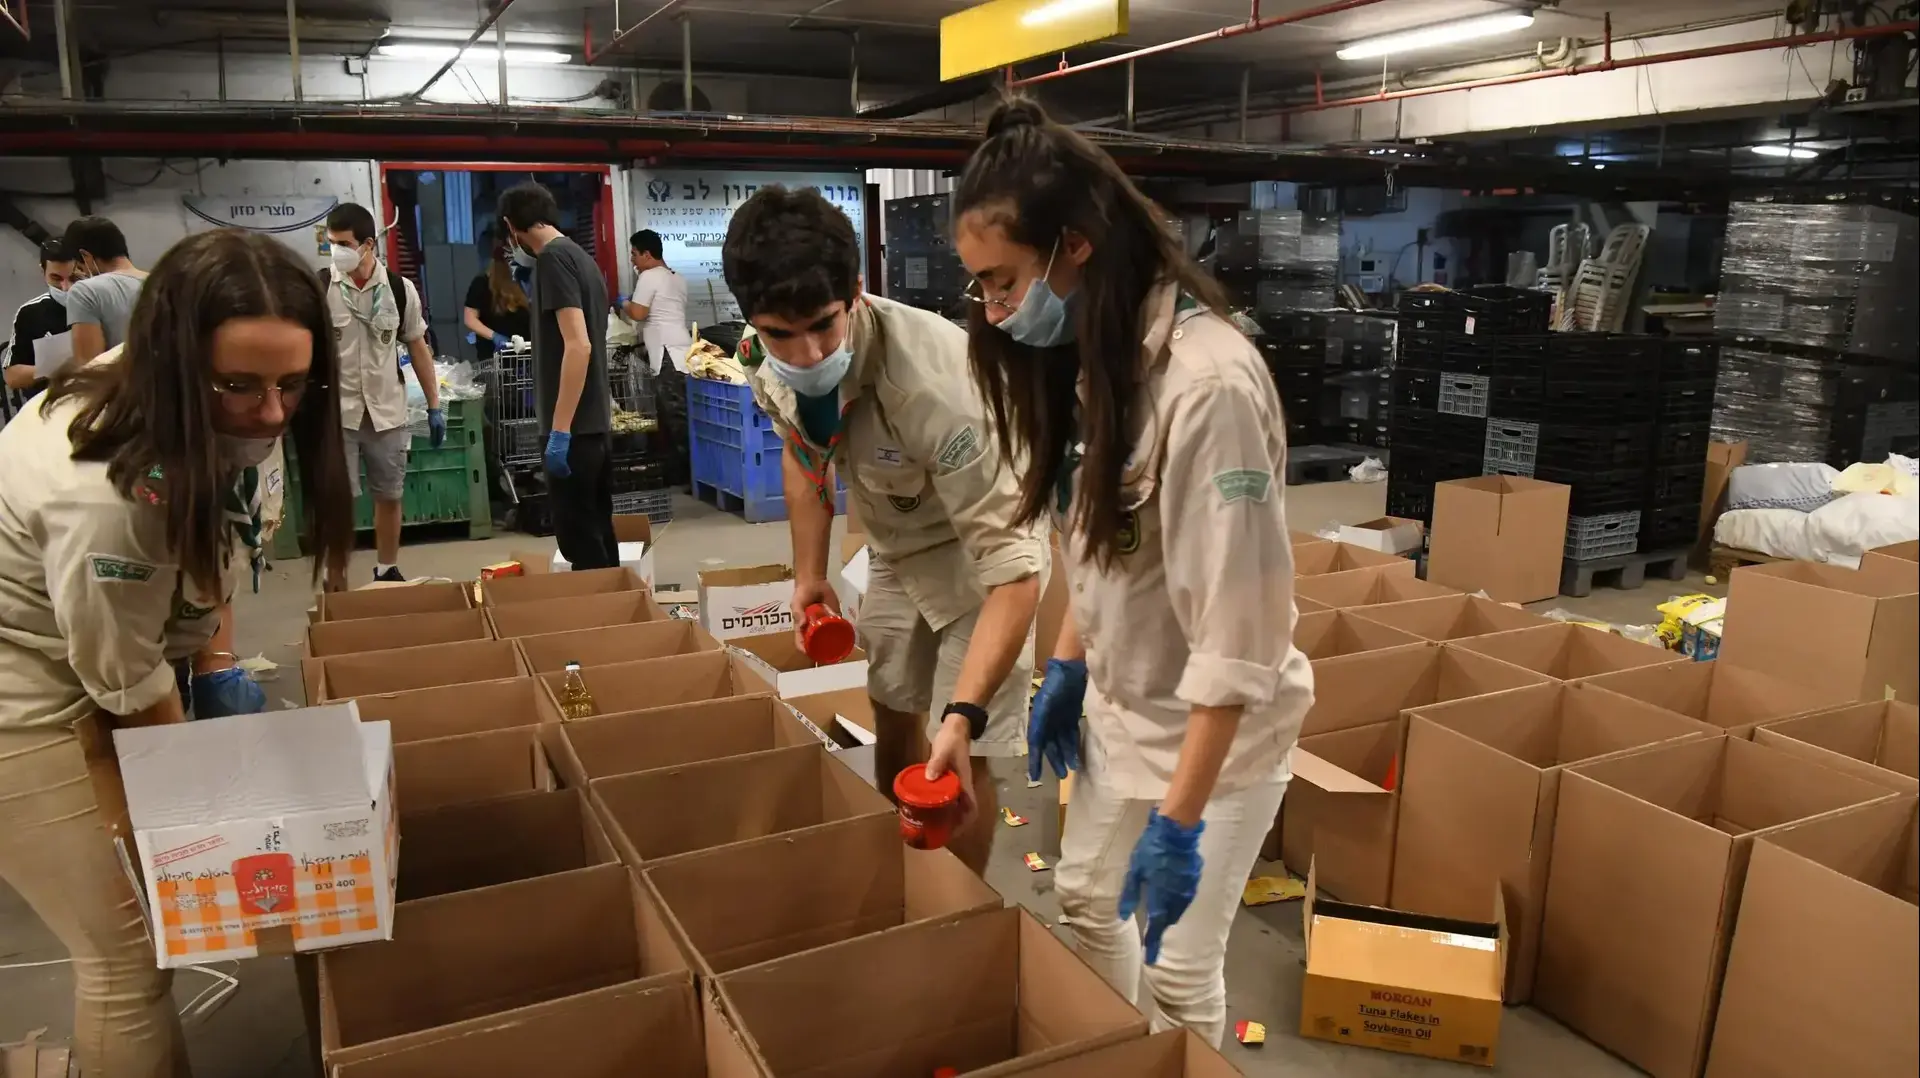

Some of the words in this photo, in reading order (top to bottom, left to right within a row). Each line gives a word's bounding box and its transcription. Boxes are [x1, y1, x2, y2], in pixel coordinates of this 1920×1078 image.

[682, 177, 711, 201] לב
[230, 205, 255, 219] מזון
[260, 203, 295, 216] מוצרי
[722, 611, 792, 630] הכורמים
[314, 880, 333, 891] גרם
[336, 878, 356, 888] 400
[1371, 990, 1432, 1008] MORGAN
[1358, 1004, 1387, 1017] Tuna
[1389, 1008, 1426, 1023] Flakes
[1428, 1014, 1440, 1024] in
[1363, 1019, 1412, 1035] Soybean
[1415, 1027, 1432, 1039] Oil
